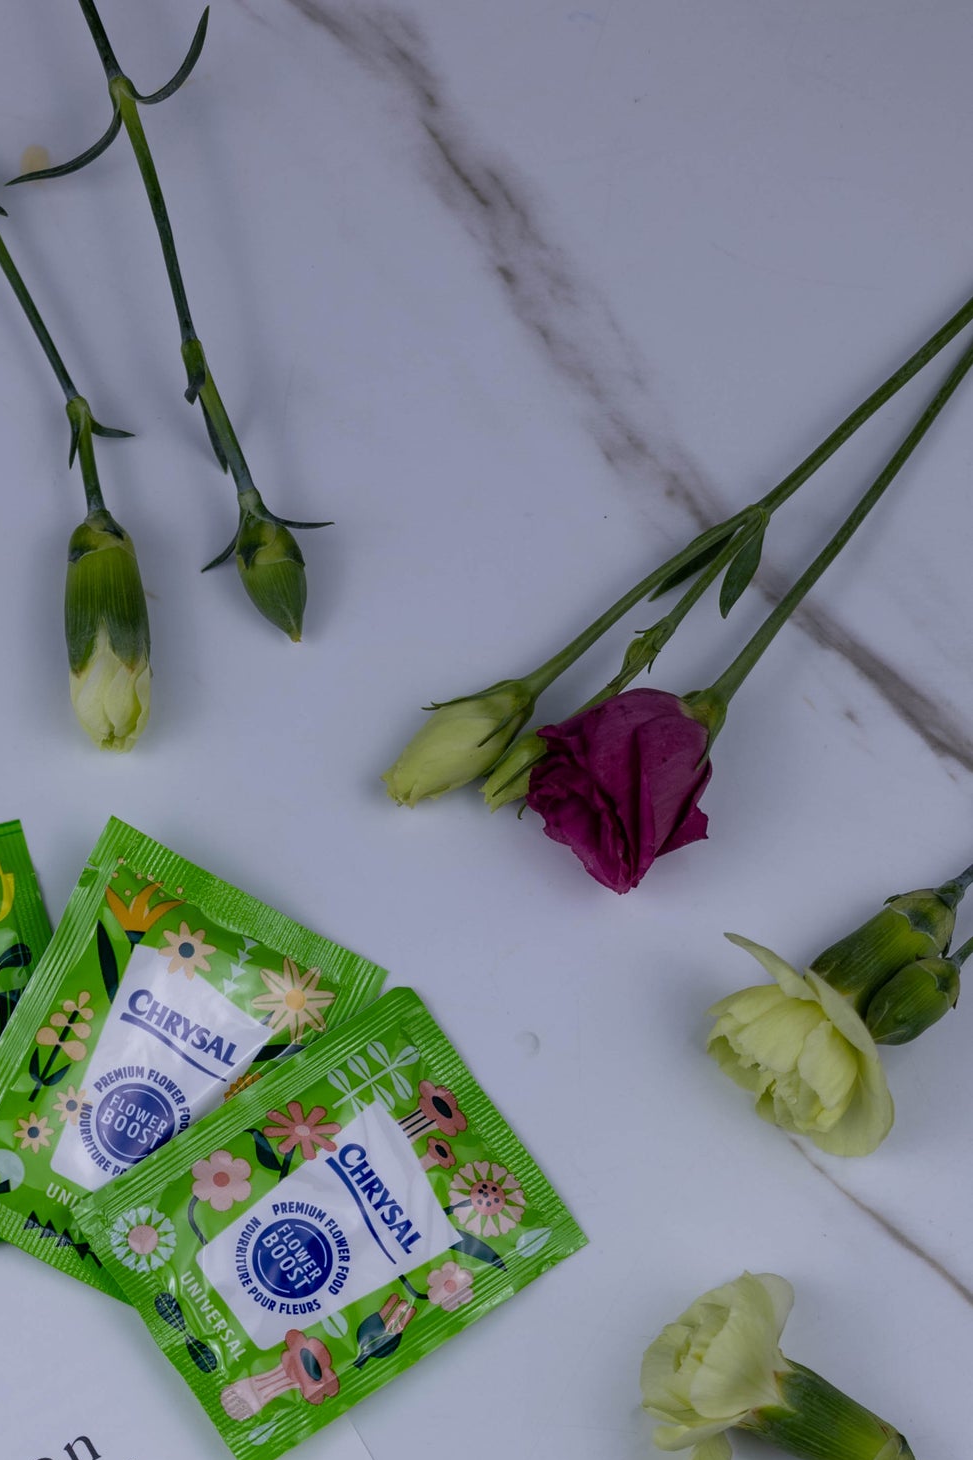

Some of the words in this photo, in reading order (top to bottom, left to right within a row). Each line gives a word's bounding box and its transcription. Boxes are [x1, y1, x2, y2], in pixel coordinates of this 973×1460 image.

[128, 989, 237, 1067] CHRYSAL
[93, 1066, 145, 1093] PREMIUM
[146, 1069, 186, 1107] FLOWER
[101, 1109, 163, 1150] BOOST
[109, 1094, 168, 1134] FLOWER
[78, 1103, 112, 1172] NOURRITURE
[271, 1201, 327, 1222] PREMIUM
[338, 1143, 422, 1254] CHRYSAL
[236, 1216, 262, 1288] NOURRITURE
[261, 1231, 312, 1290] BOOST
[277, 1224, 323, 1280] FLOWER
[325, 1218, 351, 1262] FLOWER
[248, 1286, 276, 1311] POUR
[327, 1264, 349, 1295] FOOD
[180, 1270, 247, 1361] UNIVERSAL
[278, 1298, 322, 1315] FLEURS
